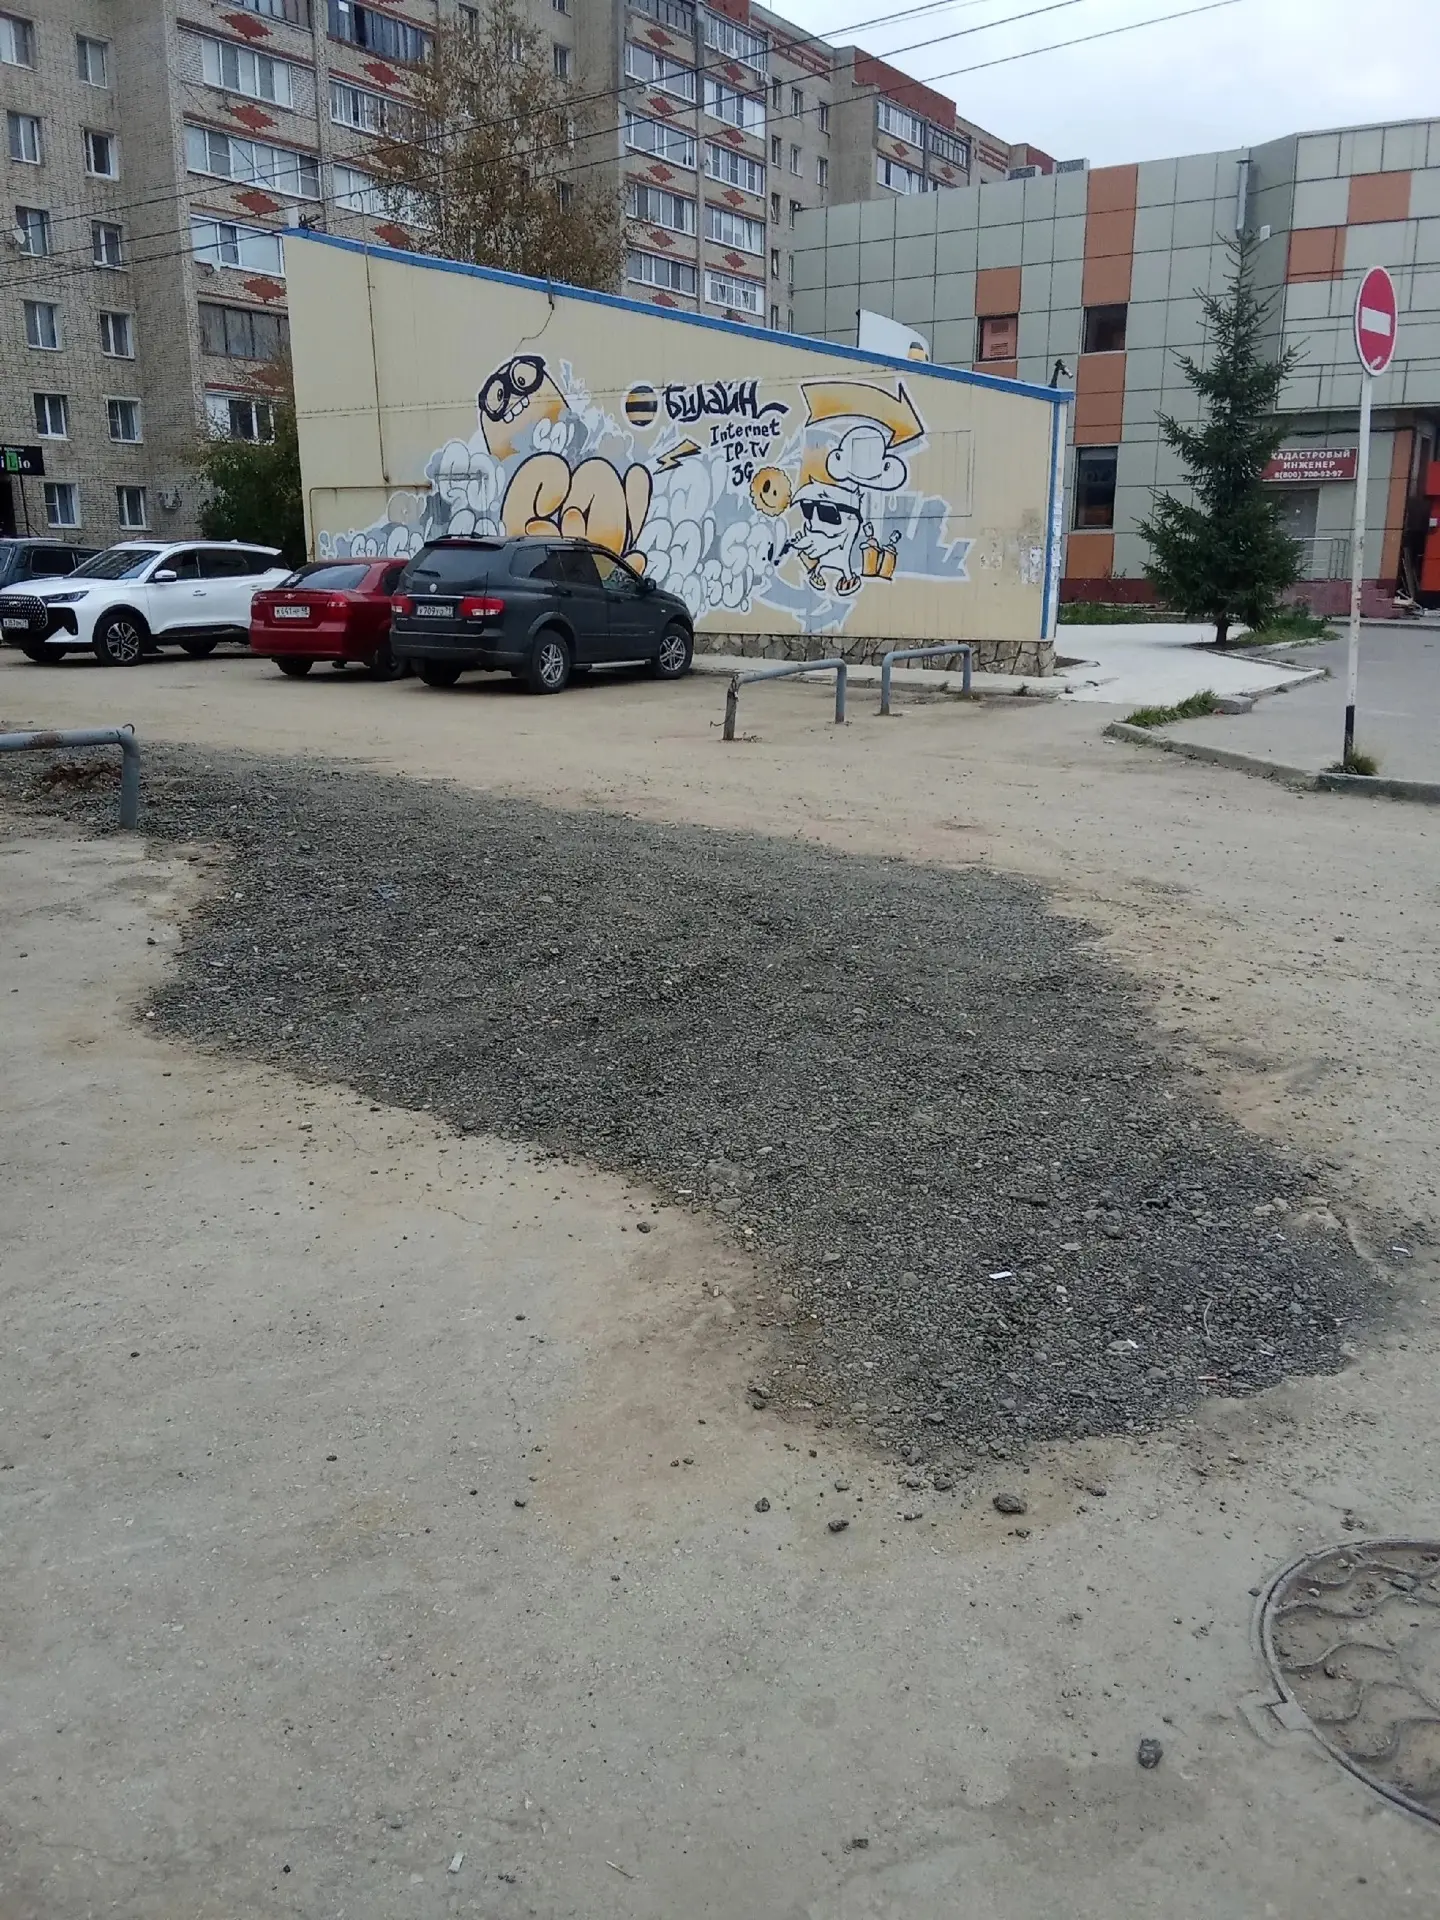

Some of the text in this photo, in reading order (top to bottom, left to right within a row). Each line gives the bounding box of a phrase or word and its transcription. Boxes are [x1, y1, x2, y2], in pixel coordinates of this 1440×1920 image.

[710, 418, 780, 446] Internet
[723, 441, 770, 462] IP-TV
[1271, 450, 1350, 460] КАДАСТРОВЫЙ
[732, 461, 754, 486] 3G
[1283, 461, 1336, 469] ИНЖЕНЕР
